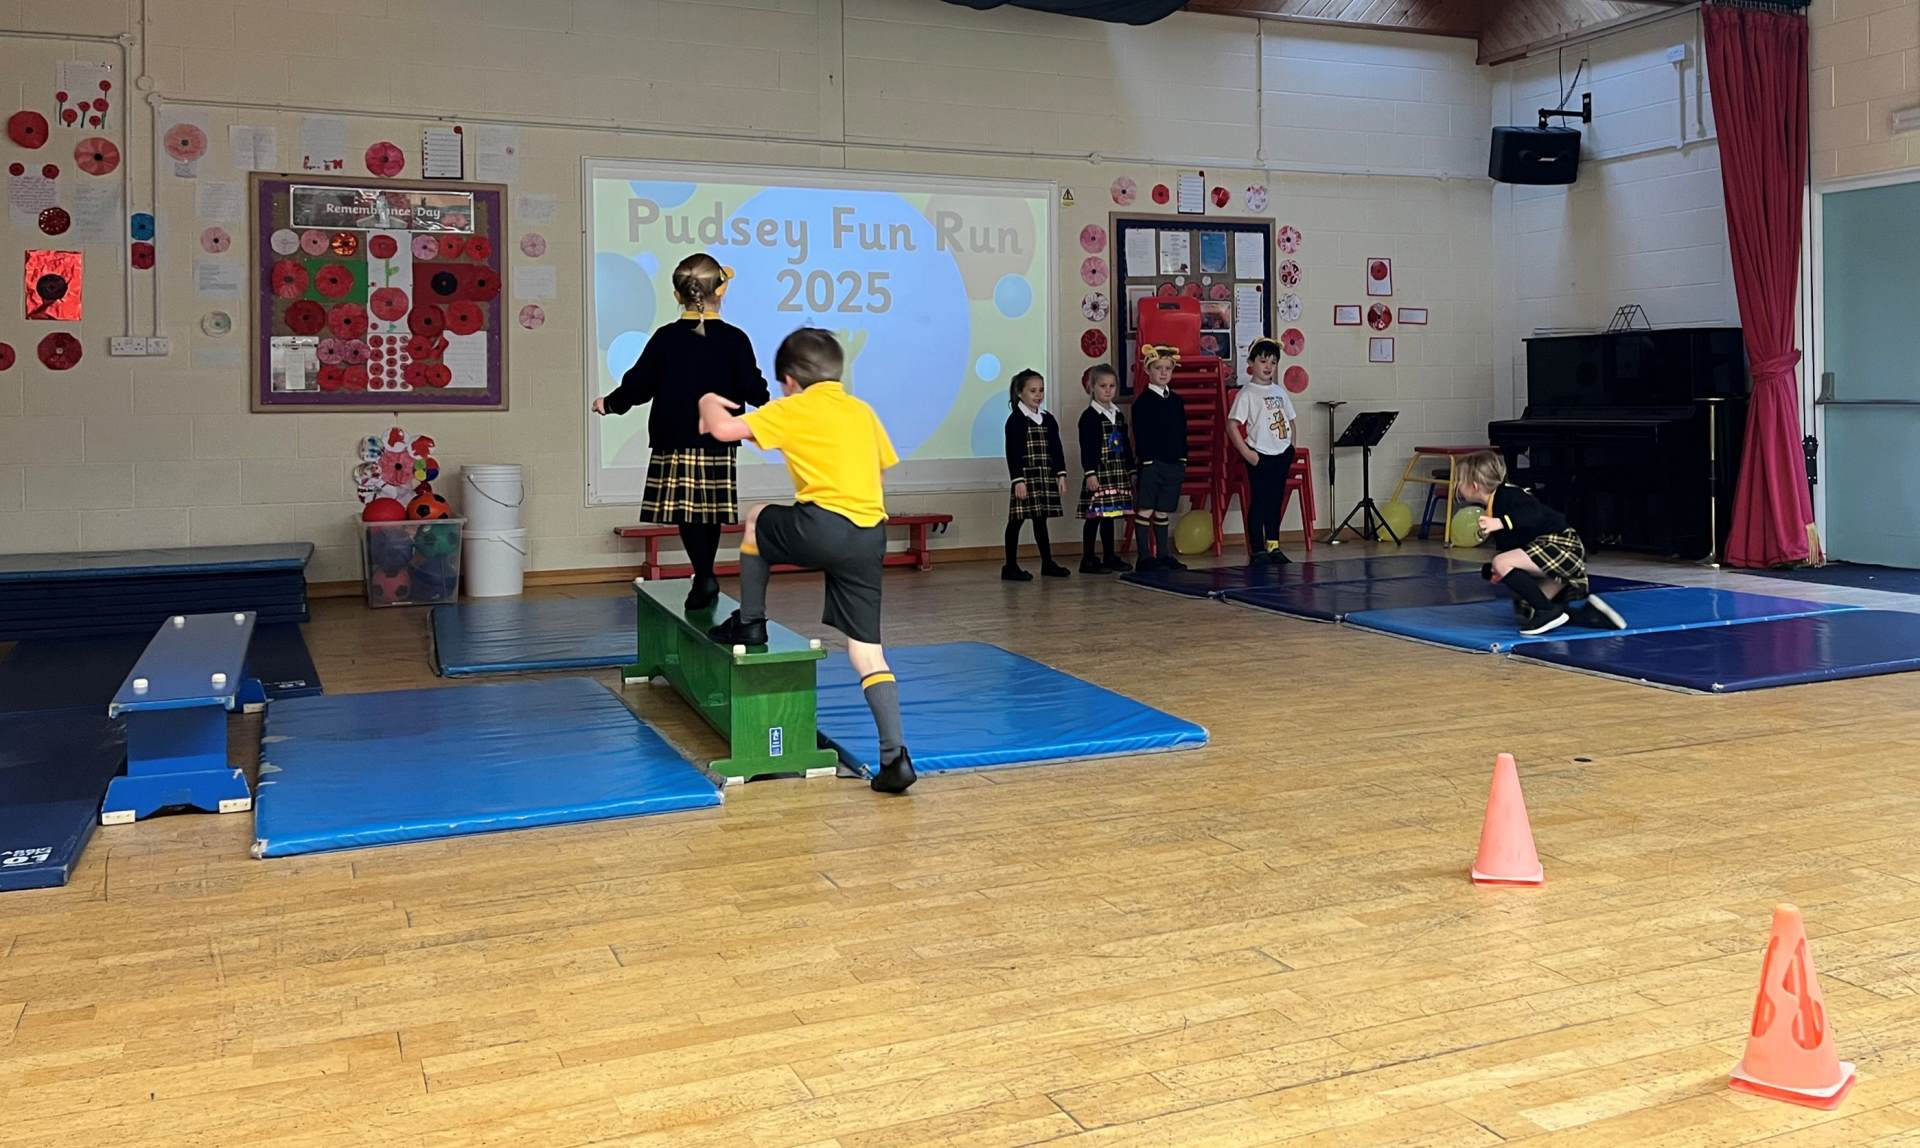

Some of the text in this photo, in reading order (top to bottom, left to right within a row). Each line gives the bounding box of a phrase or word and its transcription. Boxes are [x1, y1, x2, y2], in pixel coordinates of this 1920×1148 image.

[417, 207, 441, 220] Day
[628, 198, 1024, 265] Pudsey Fun Run
[776, 268, 892, 314] 2025
